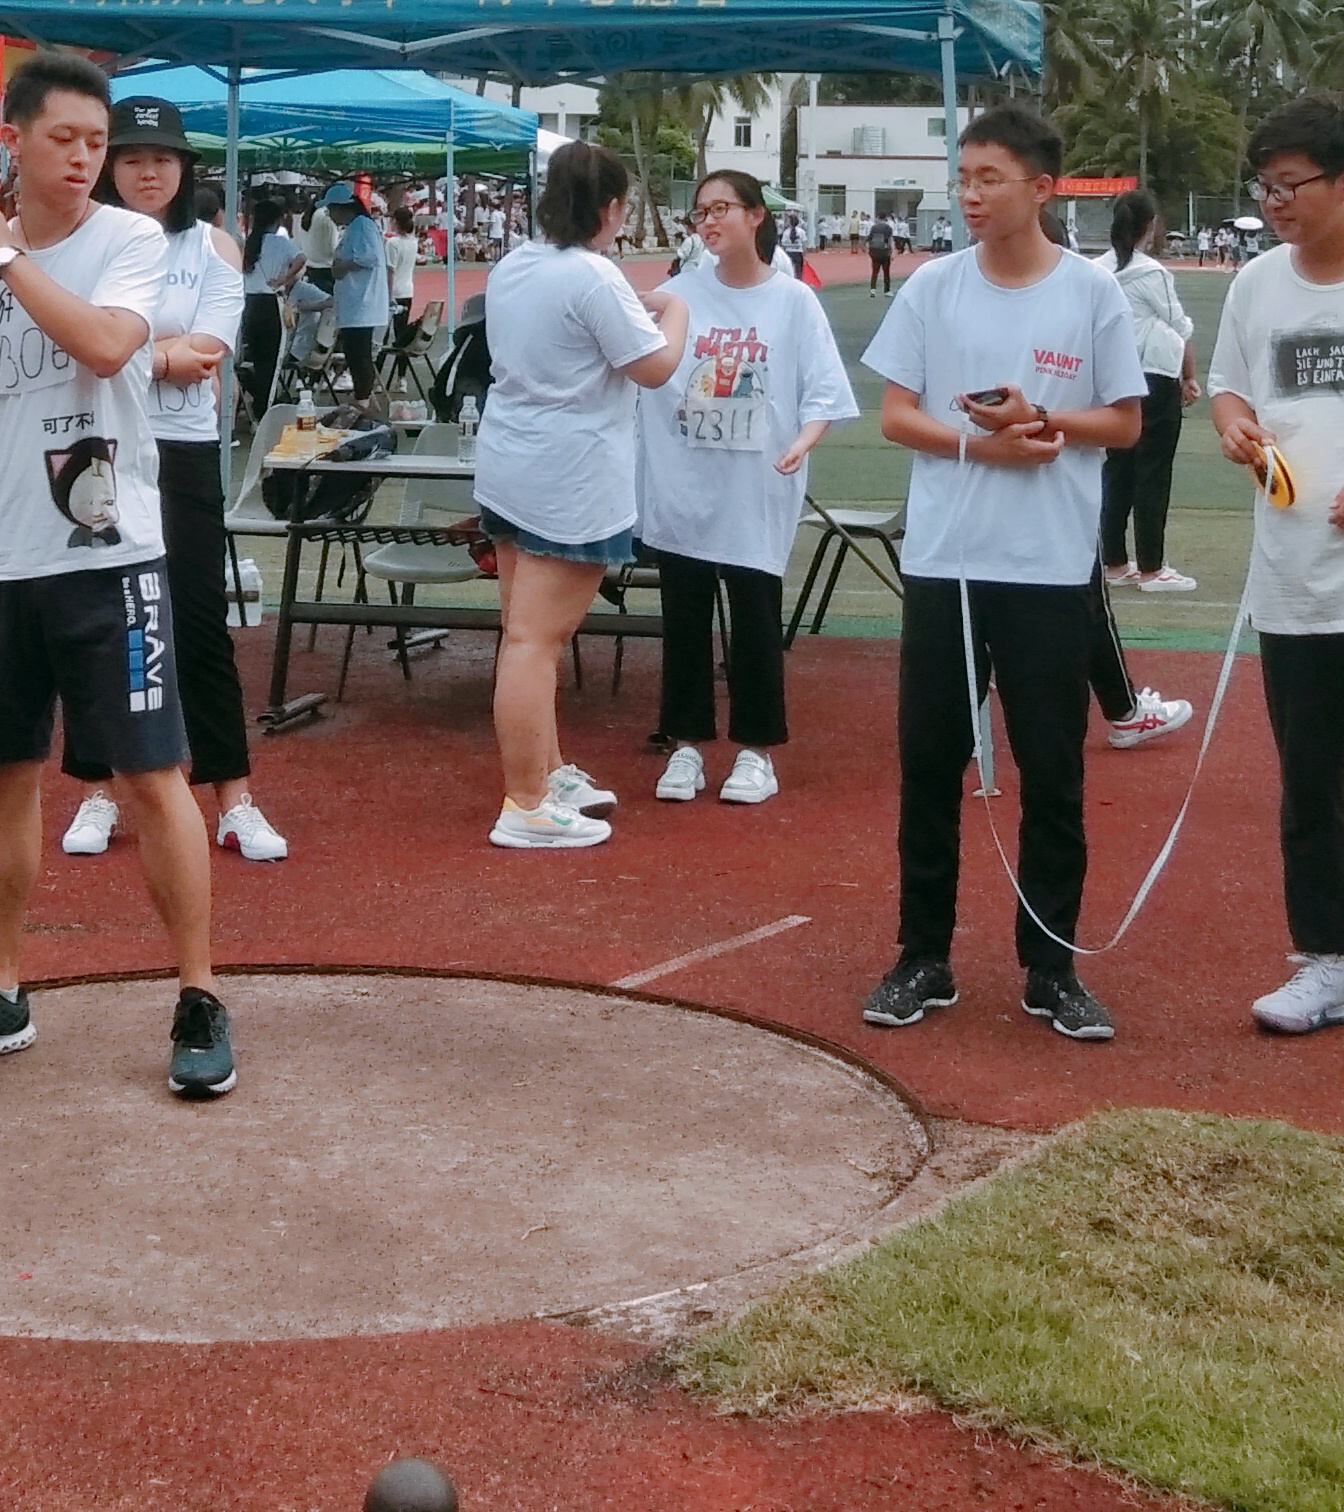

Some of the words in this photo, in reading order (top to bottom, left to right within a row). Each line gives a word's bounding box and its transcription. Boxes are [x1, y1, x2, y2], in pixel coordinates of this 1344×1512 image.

[1033, 349, 1084, 372] VAUNT
[1296, 358, 1312, 370] SIE
[1297, 371, 1309, 386] ES
[692, 408, 753, 442] 2311
[138, 571, 166, 712] BRAVE
